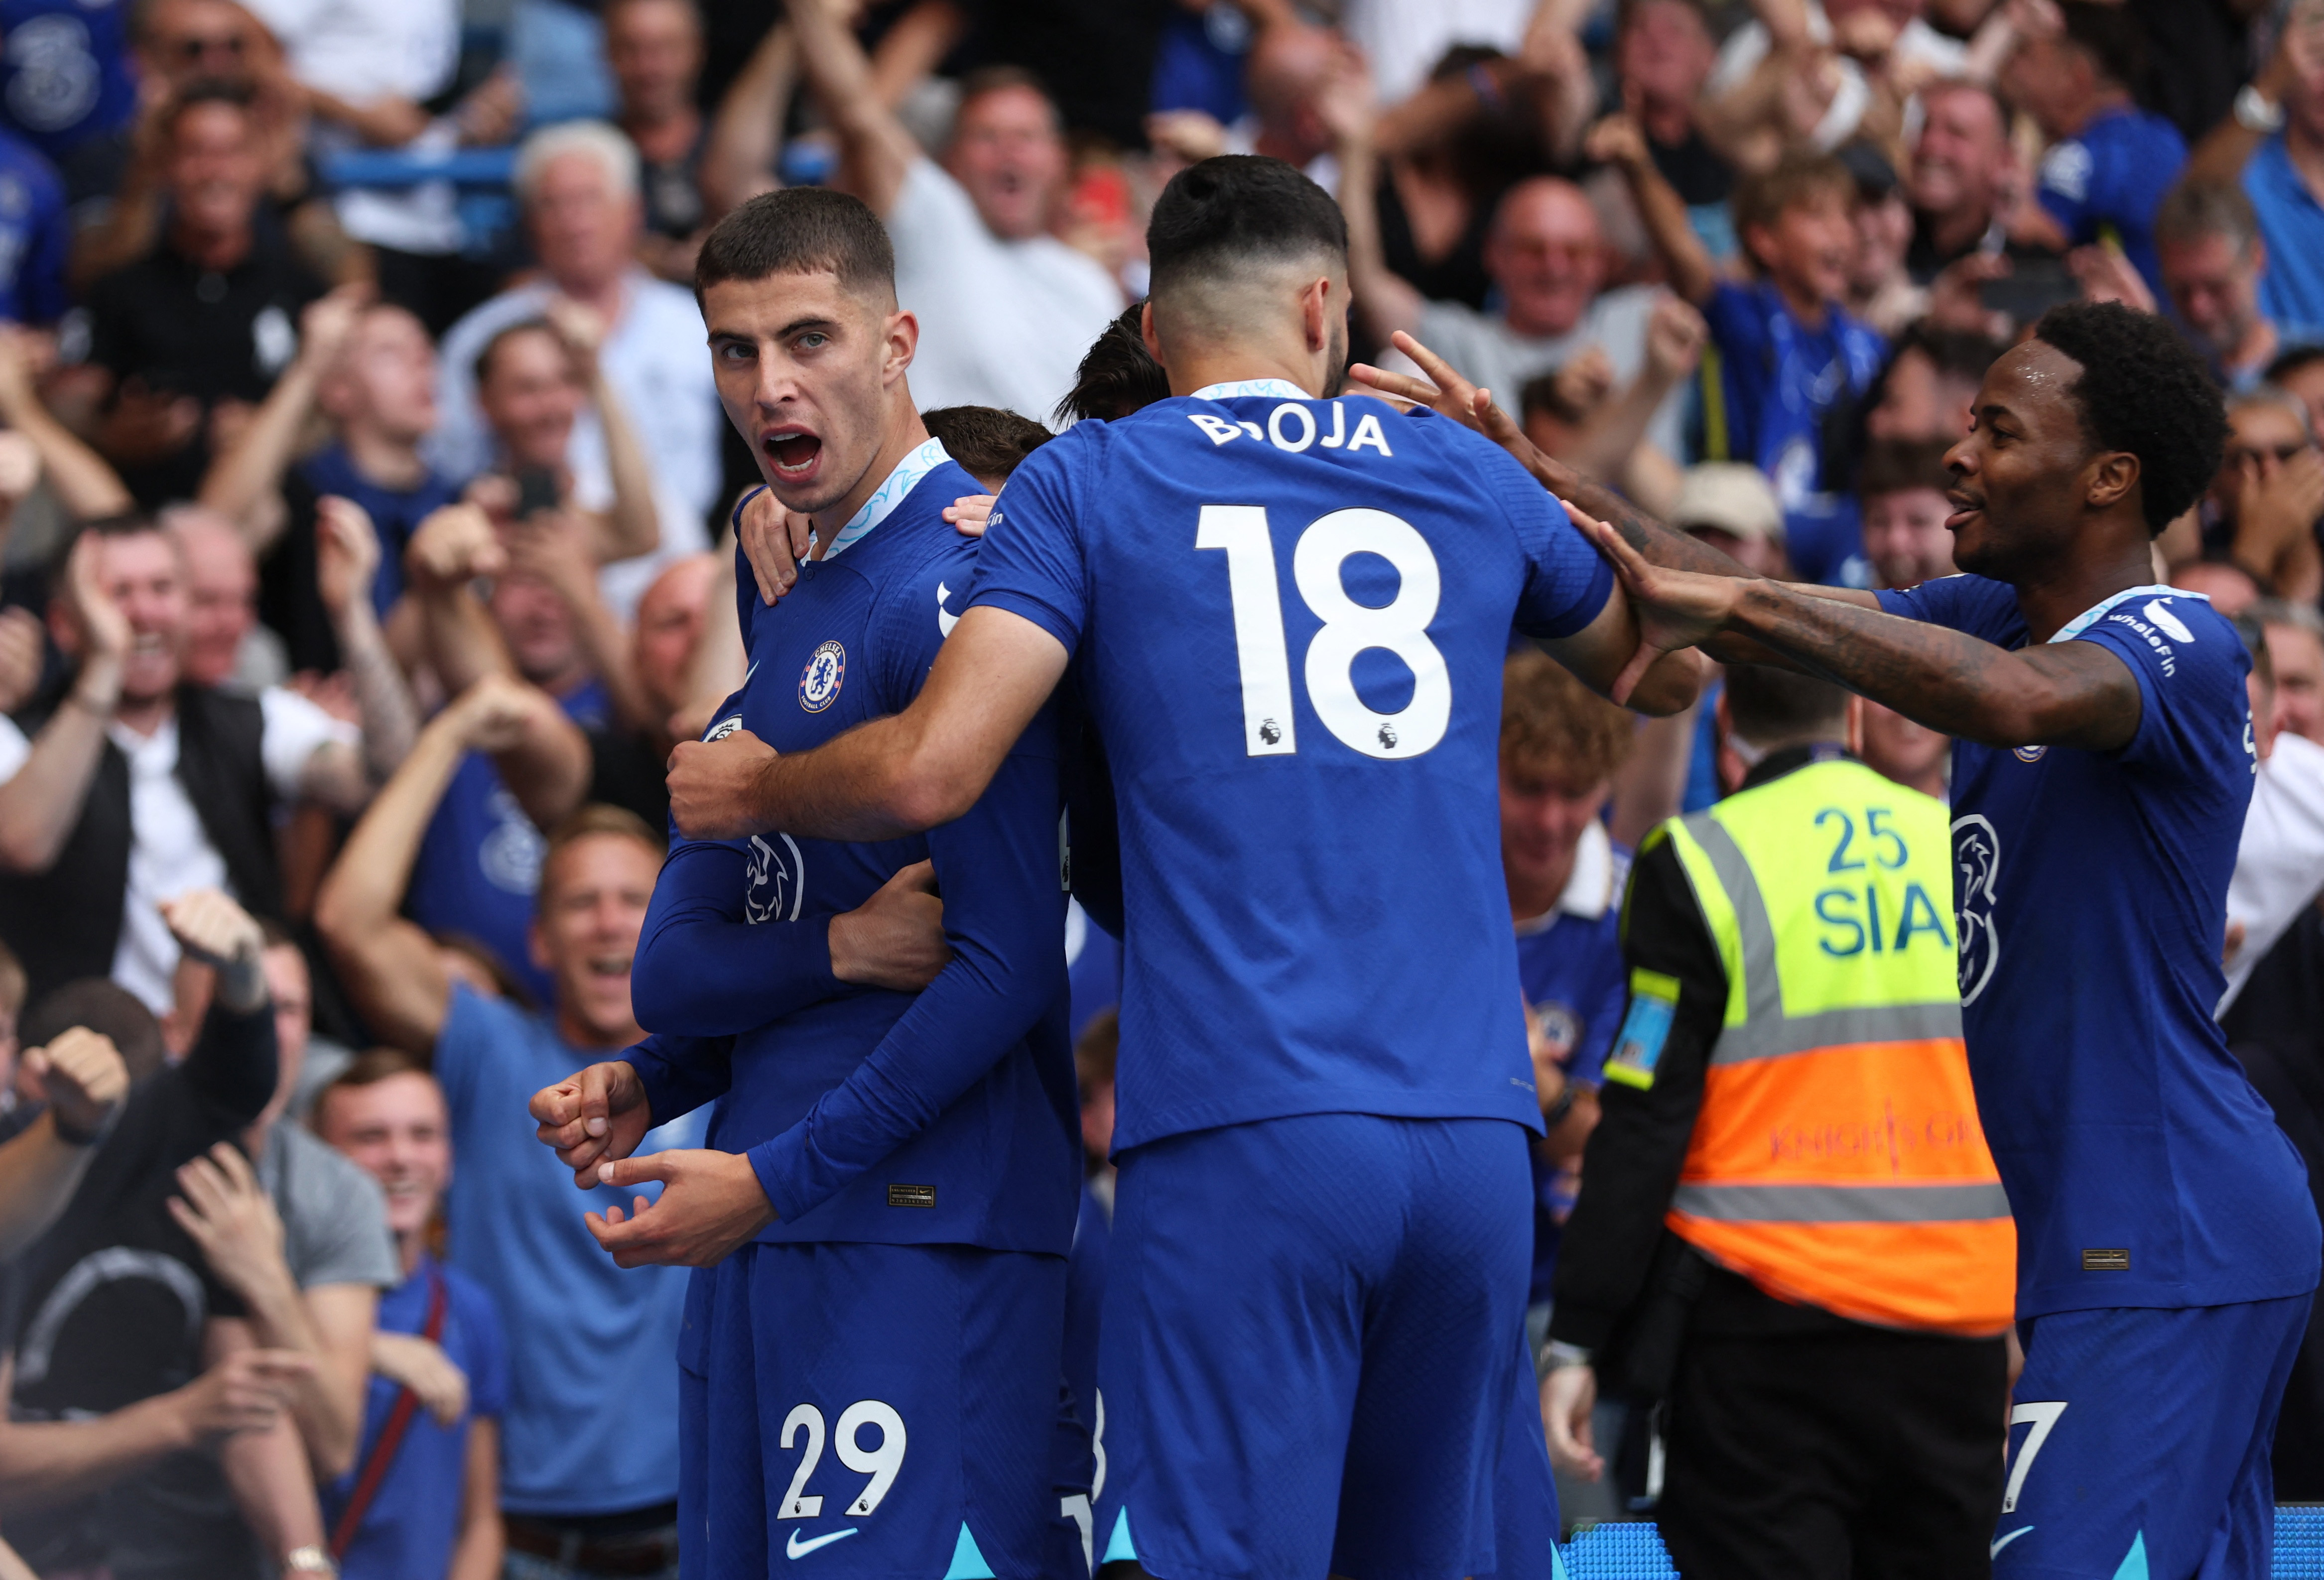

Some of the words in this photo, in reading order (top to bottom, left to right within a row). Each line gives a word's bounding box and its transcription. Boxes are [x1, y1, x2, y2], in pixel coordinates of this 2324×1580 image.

[815, 643, 842, 658] CHELSEA
[1195, 504, 1451, 759] 18
[801, 695, 818, 709] FOOTBALL
[820, 696, 831, 707] CLUB
[1815, 808, 1908, 872] 25
[1815, 883, 1951, 955] SIA
[777, 1400, 906, 1519] 29
[2001, 1401, 2068, 1514] 7
